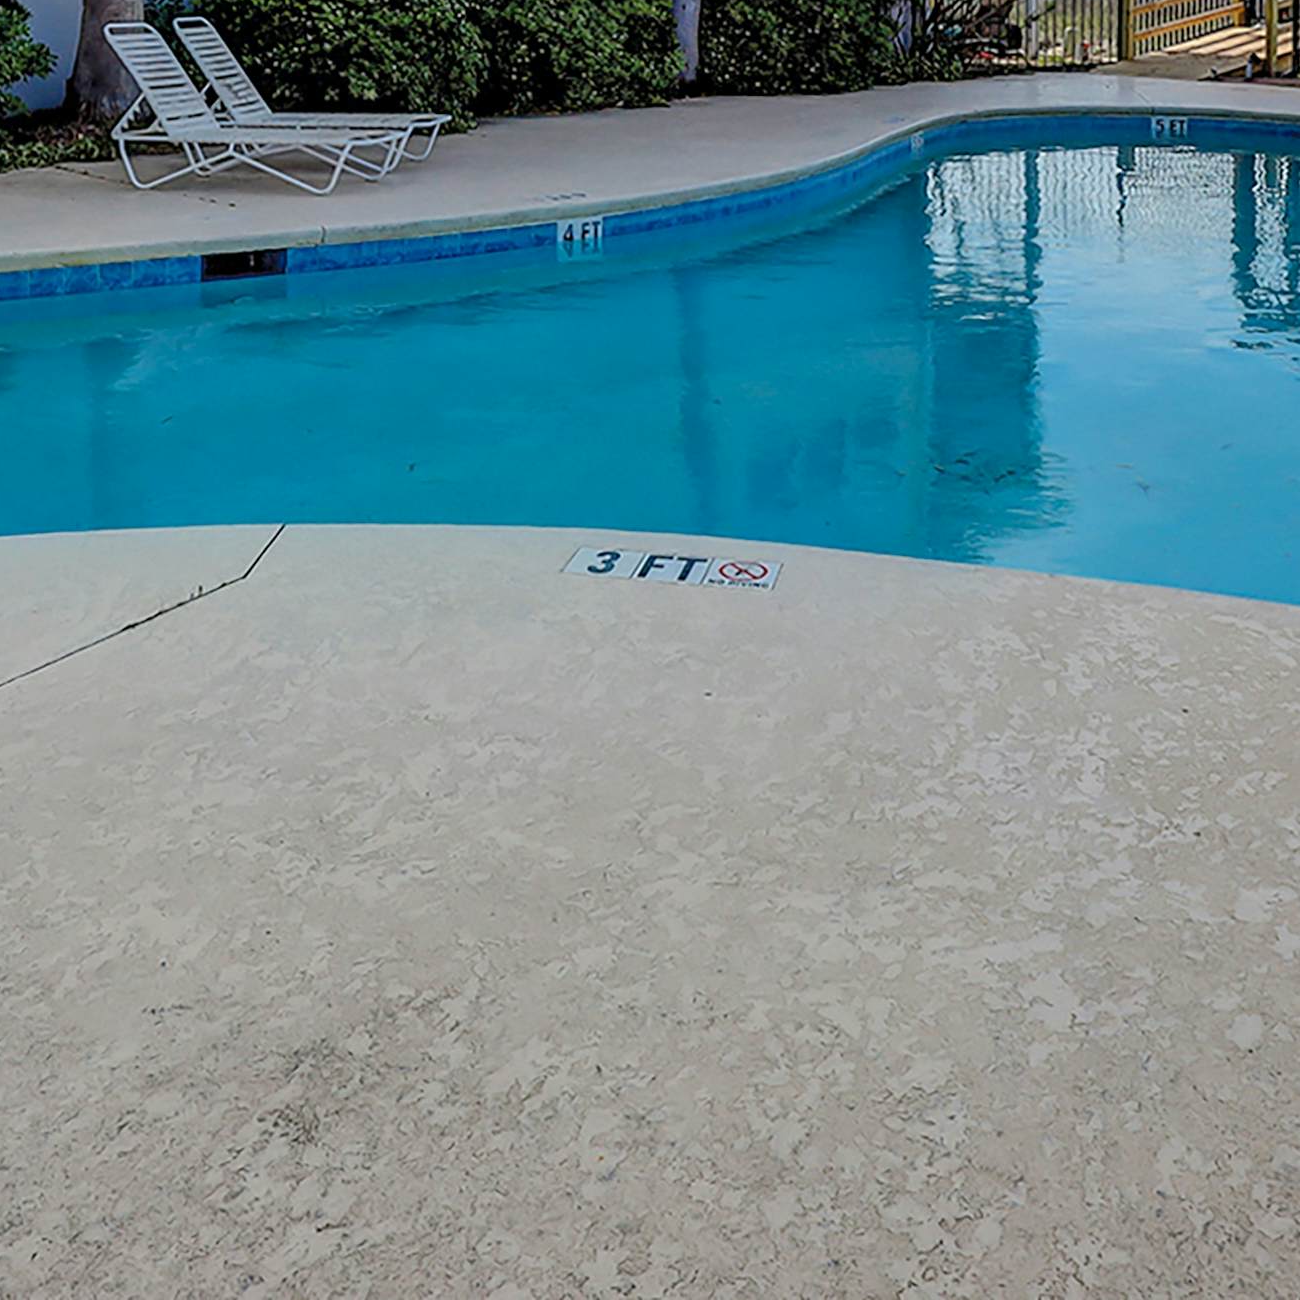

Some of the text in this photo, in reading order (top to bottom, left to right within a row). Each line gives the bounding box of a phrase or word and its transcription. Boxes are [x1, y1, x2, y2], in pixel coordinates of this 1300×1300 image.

[1155, 118, 1165, 134] 5
[563, 220, 602, 242] 4 FT
[587, 551, 708, 581] 3 FT
